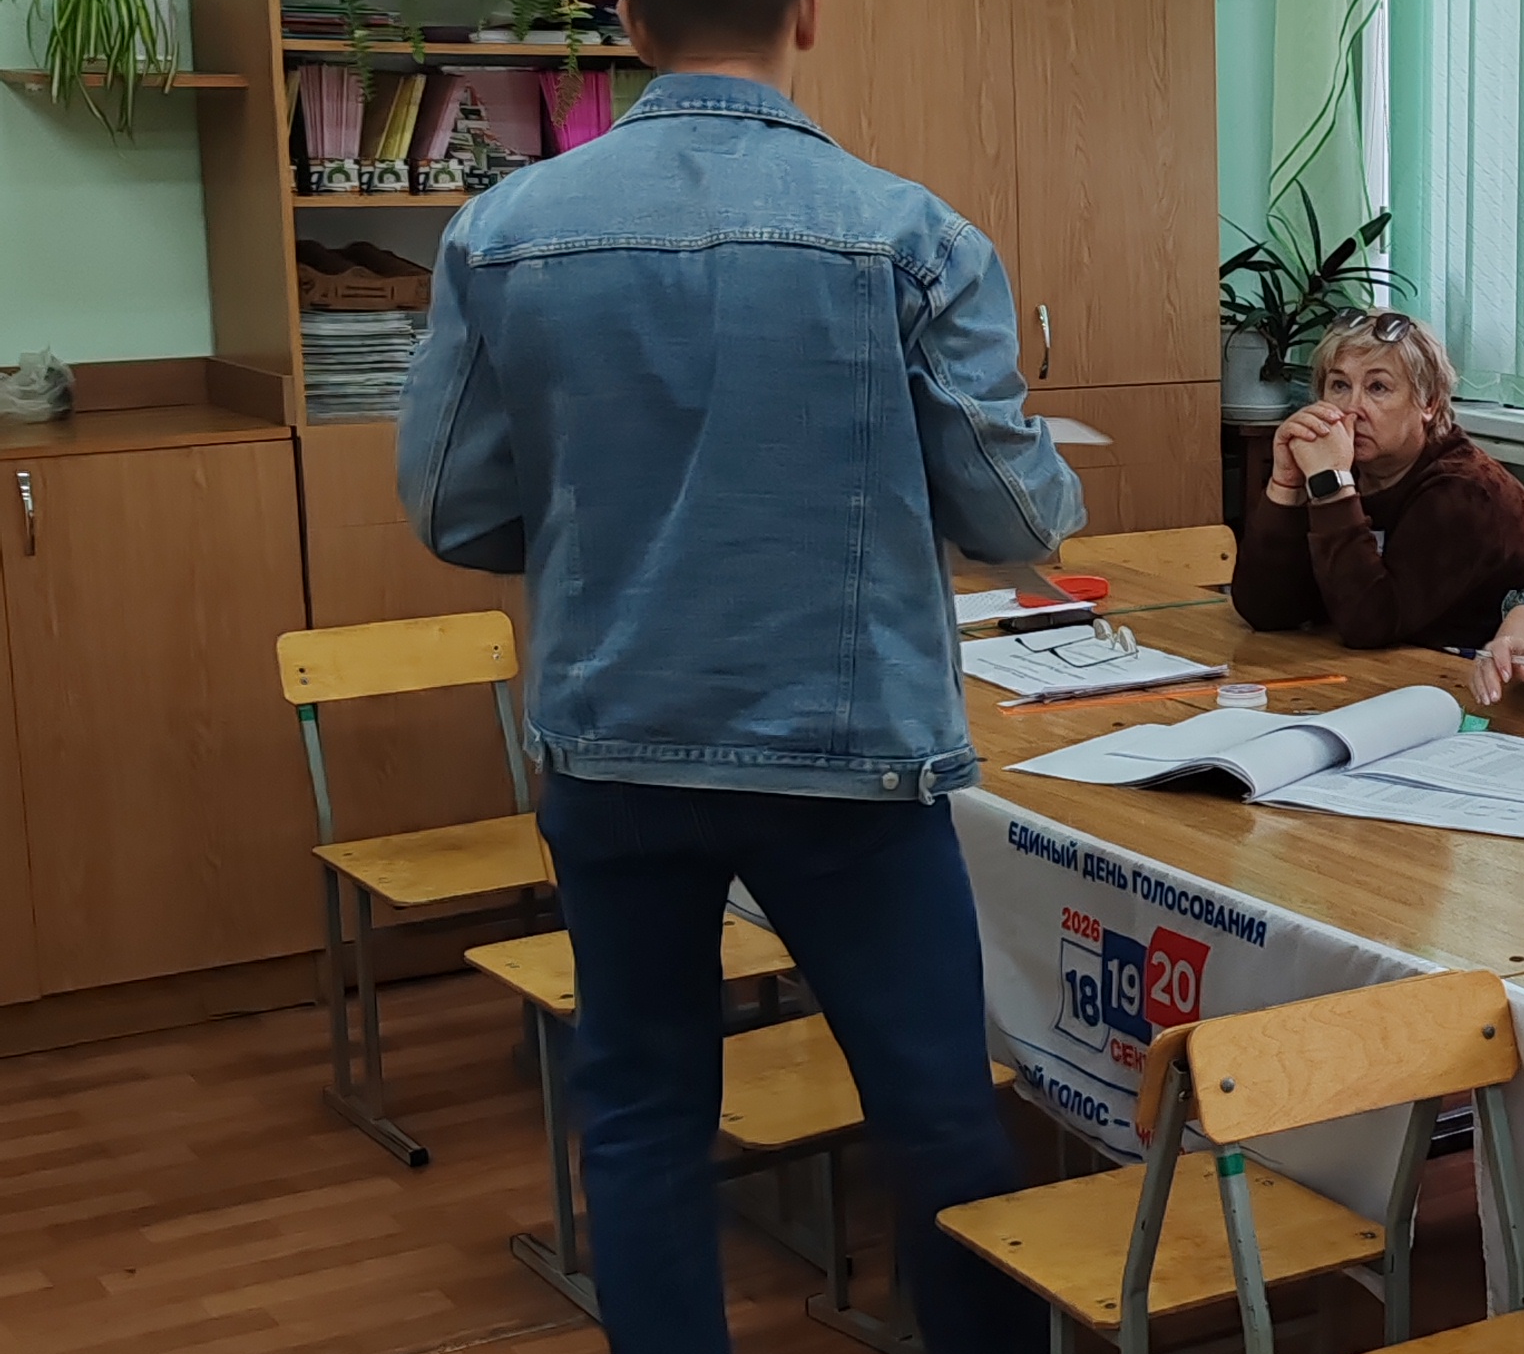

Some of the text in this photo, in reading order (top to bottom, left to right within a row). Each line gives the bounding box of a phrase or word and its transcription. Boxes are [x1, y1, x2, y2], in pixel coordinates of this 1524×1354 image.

[1008, 821, 1267, 947] ЕДИНЫЙ ДЕНЬ ГОЛОСОВАНИЯ
[1061, 907, 1101, 942] 2026
[1065, 951, 1196, 1027] 18 19 20
[1048, 1077, 1110, 1127] ГОЛОС
